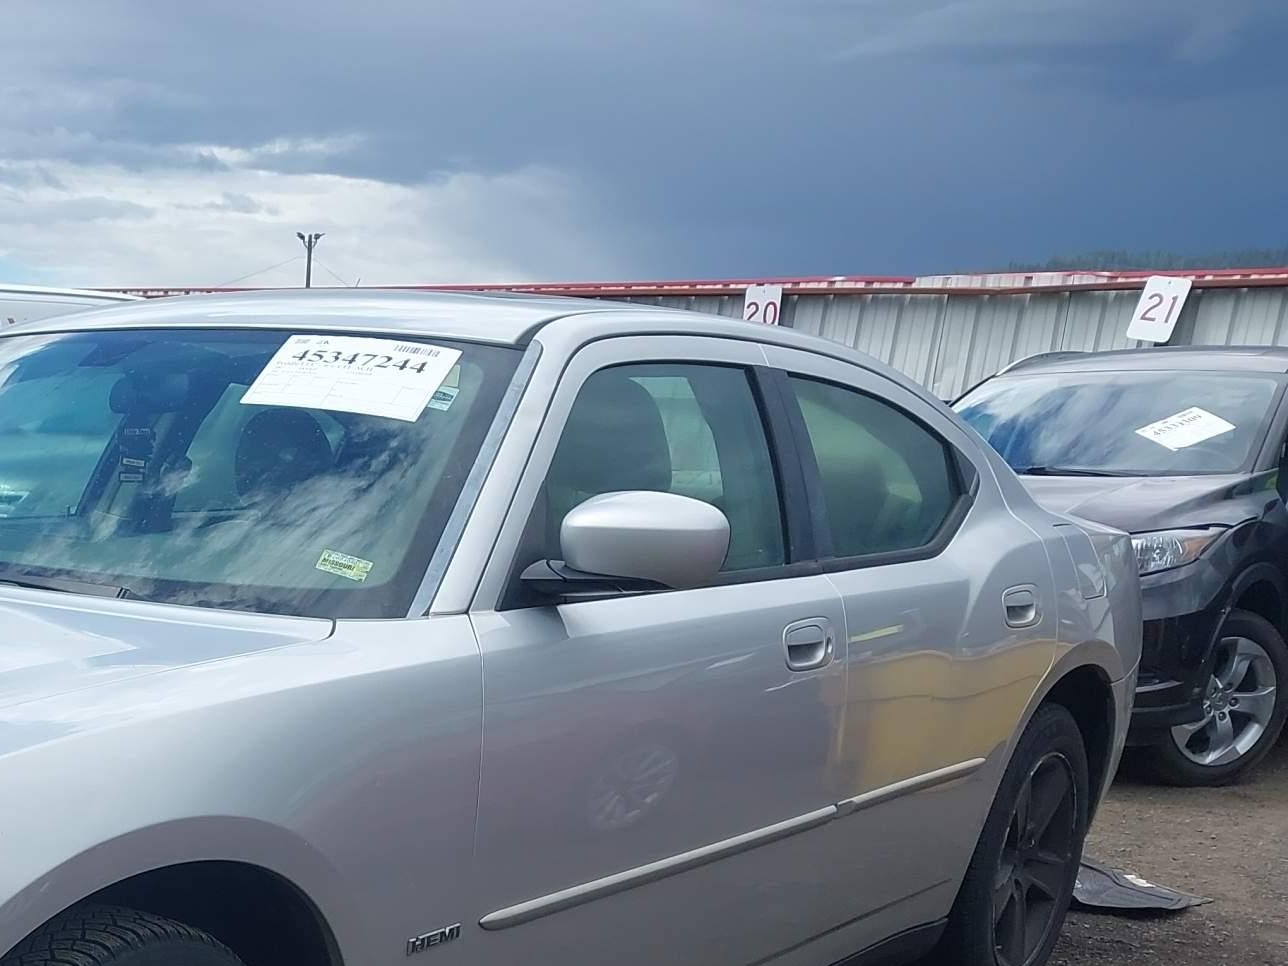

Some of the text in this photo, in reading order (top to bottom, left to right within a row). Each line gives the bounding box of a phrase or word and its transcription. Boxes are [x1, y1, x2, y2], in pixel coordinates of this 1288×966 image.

[746, 301, 778, 325] 20
[1139, 293, 1179, 323] 21
[292, 348, 428, 374] 45347244
[322, 557, 355, 571] MISSOURI
[407, 922, 461, 956] HEMI
